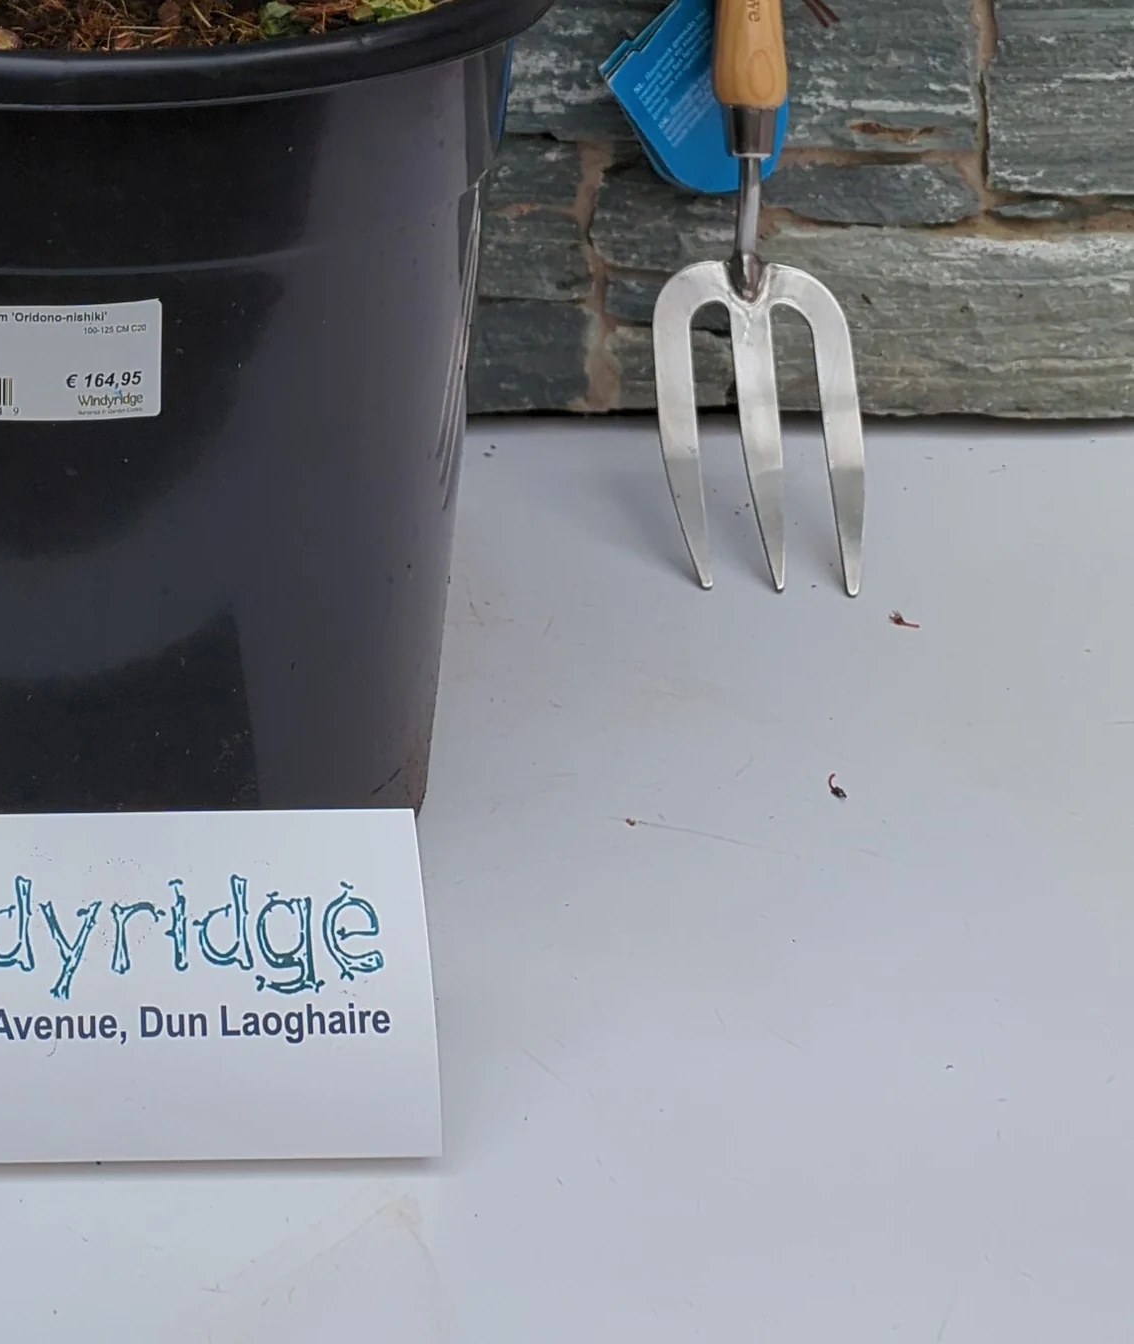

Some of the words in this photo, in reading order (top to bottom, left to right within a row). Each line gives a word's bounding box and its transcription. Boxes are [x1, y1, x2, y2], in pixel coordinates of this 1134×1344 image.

[11, 311, 108, 323] 'Oridono-nishiki'
[84, 325, 114, 335] 100-125
[116, 324, 130, 333] CM
[65, 373, 78, 388] €
[84, 370, 142, 389] 164,95
[77, 391, 143, 408] Windyridge
[13, 406, 20, 416] 9
[140, 1004, 208, 1038] Dun
[220, 1000, 392, 1043] Laoghaire
